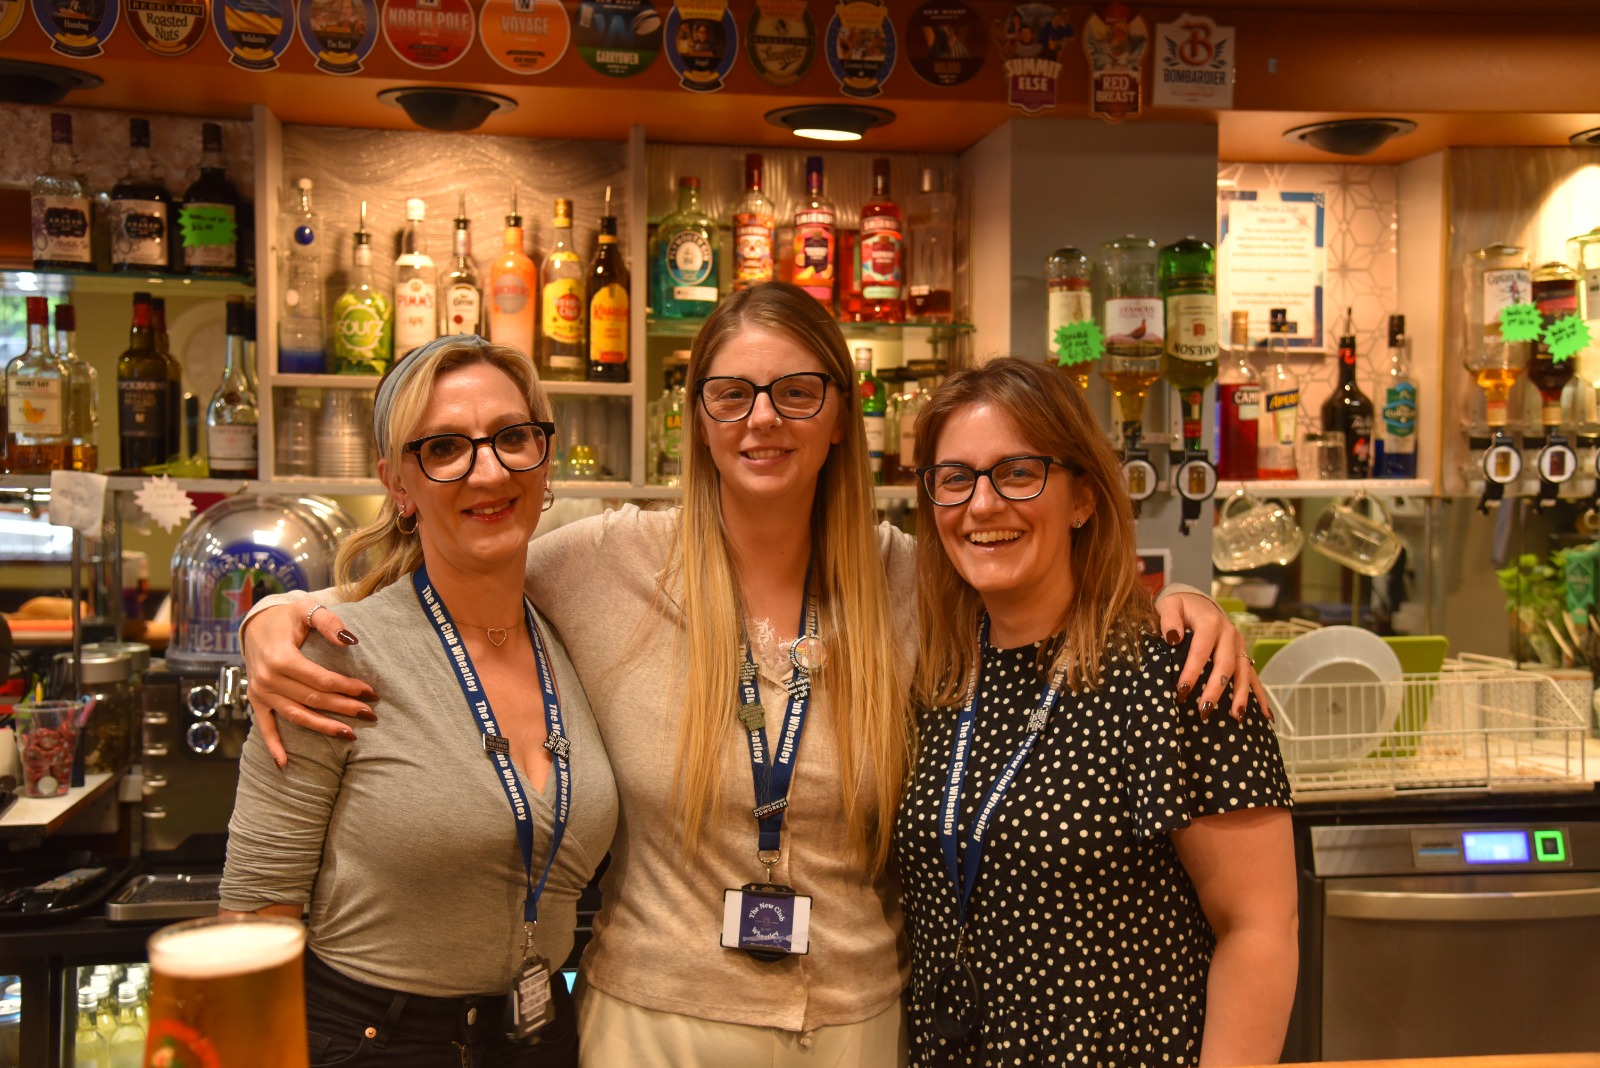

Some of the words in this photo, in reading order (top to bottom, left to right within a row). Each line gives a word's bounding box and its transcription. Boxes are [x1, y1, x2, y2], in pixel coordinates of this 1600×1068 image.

[146, 13, 188, 28] Roasted
[389, 9, 433, 28] NORTH
[436, 12, 469, 30] POLE
[501, 15, 550, 35] VOYAGE
[155, 27, 180, 41] Nuts
[1018, 76, 1048, 92] ELSE
[1102, 76, 1130, 91] RED
[1163, 69, 1226, 85] BOMBARDIER
[1096, 91, 1137, 104] BREAST
[422, 585, 435, 605] The
[429, 602, 447, 625] New
[440, 623, 459, 646] Club
[451, 645, 479, 692] Wheatley
[537, 650, 554, 695] Wheatley
[779, 715, 801, 765] Wheatley
[960, 720, 970, 739] The
[751, 729, 764, 764] eatley
[956, 739, 967, 760] New
[475, 700, 490, 720] The
[502, 769, 528, 821] Wheatley
[548, 704, 560, 722] The
[559, 770, 570, 824] Wheatley
[1011, 748, 1028, 769] New
[951, 761, 964, 785] Club
[995, 769, 1015, 792] Club
[754, 801, 789, 818] COWORKER
[944, 785, 959, 836] Wheatley
[973, 792, 1001, 843] Wheatley
[748, 907, 760, 919] The
[759, 902, 774, 910] New
[773, 906, 787, 922] Club
[752, 926, 779, 940] Wheatley
